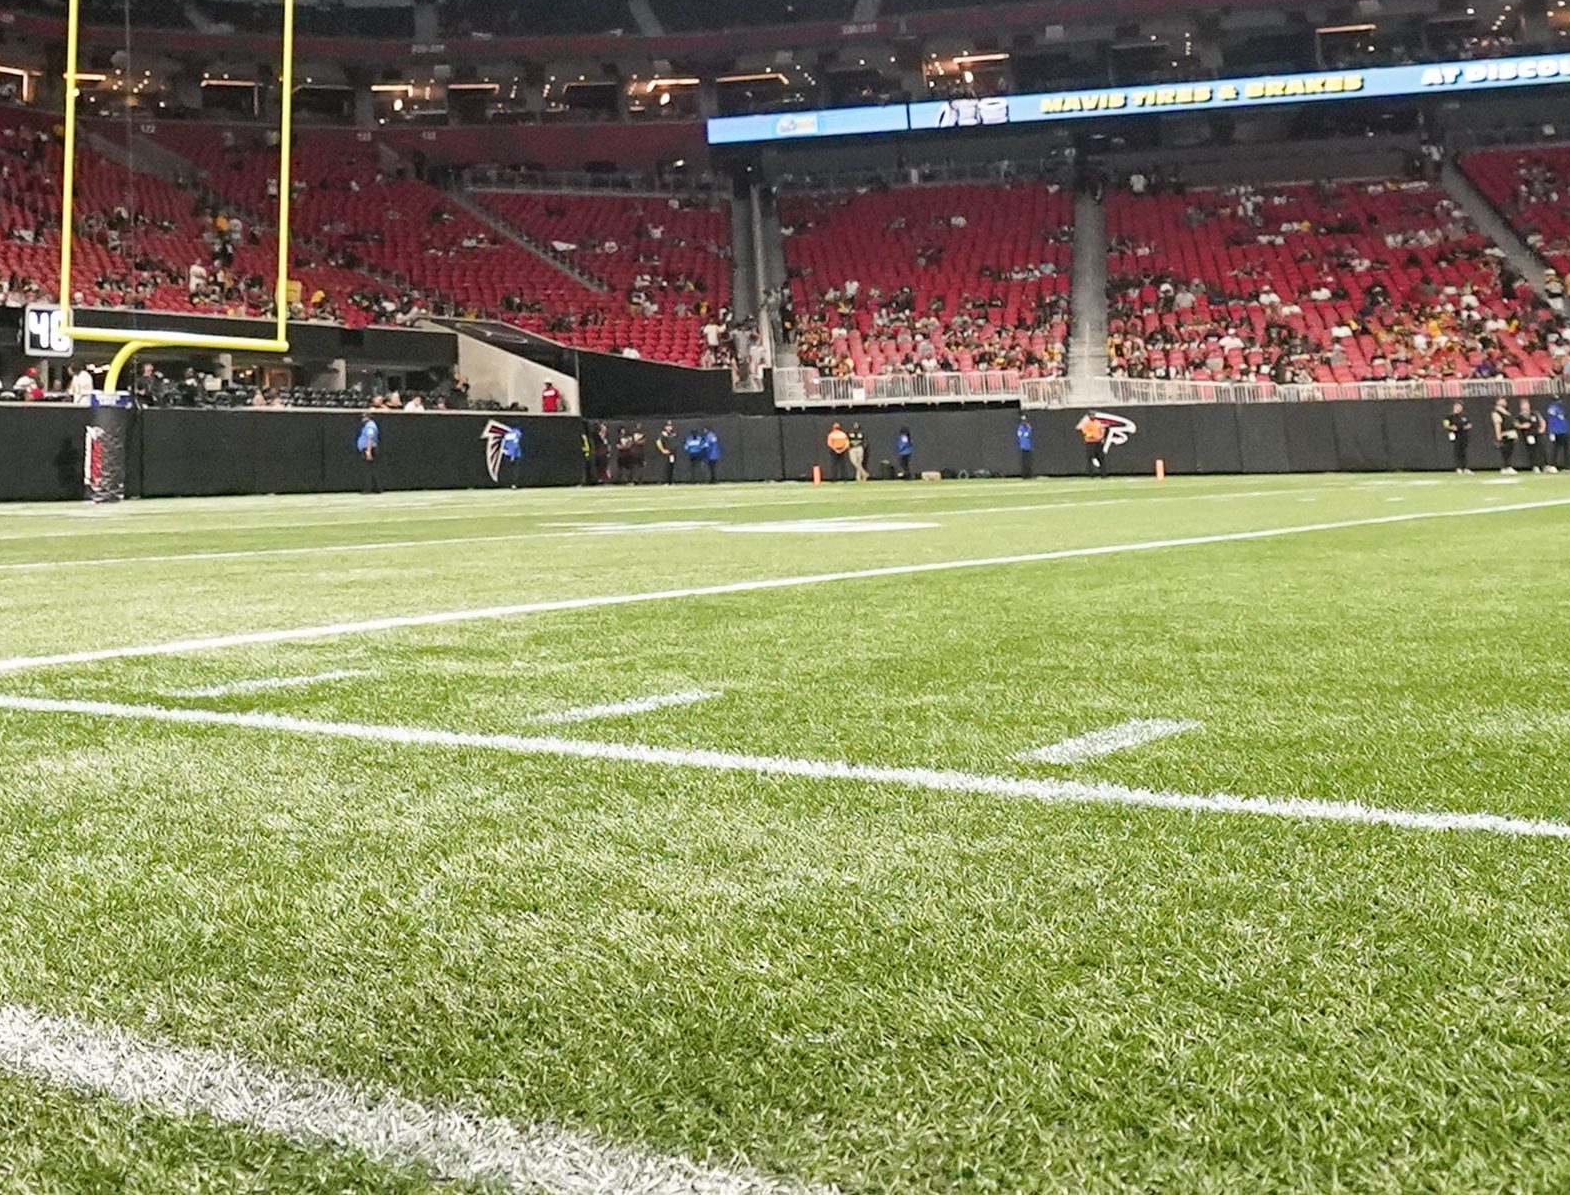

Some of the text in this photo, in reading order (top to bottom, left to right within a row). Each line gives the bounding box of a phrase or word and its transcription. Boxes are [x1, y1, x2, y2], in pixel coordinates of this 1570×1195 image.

[1420, 67, 1463, 87] AT
[1039, 74, 1364, 114] MAVIS TIRES & BRAKES
